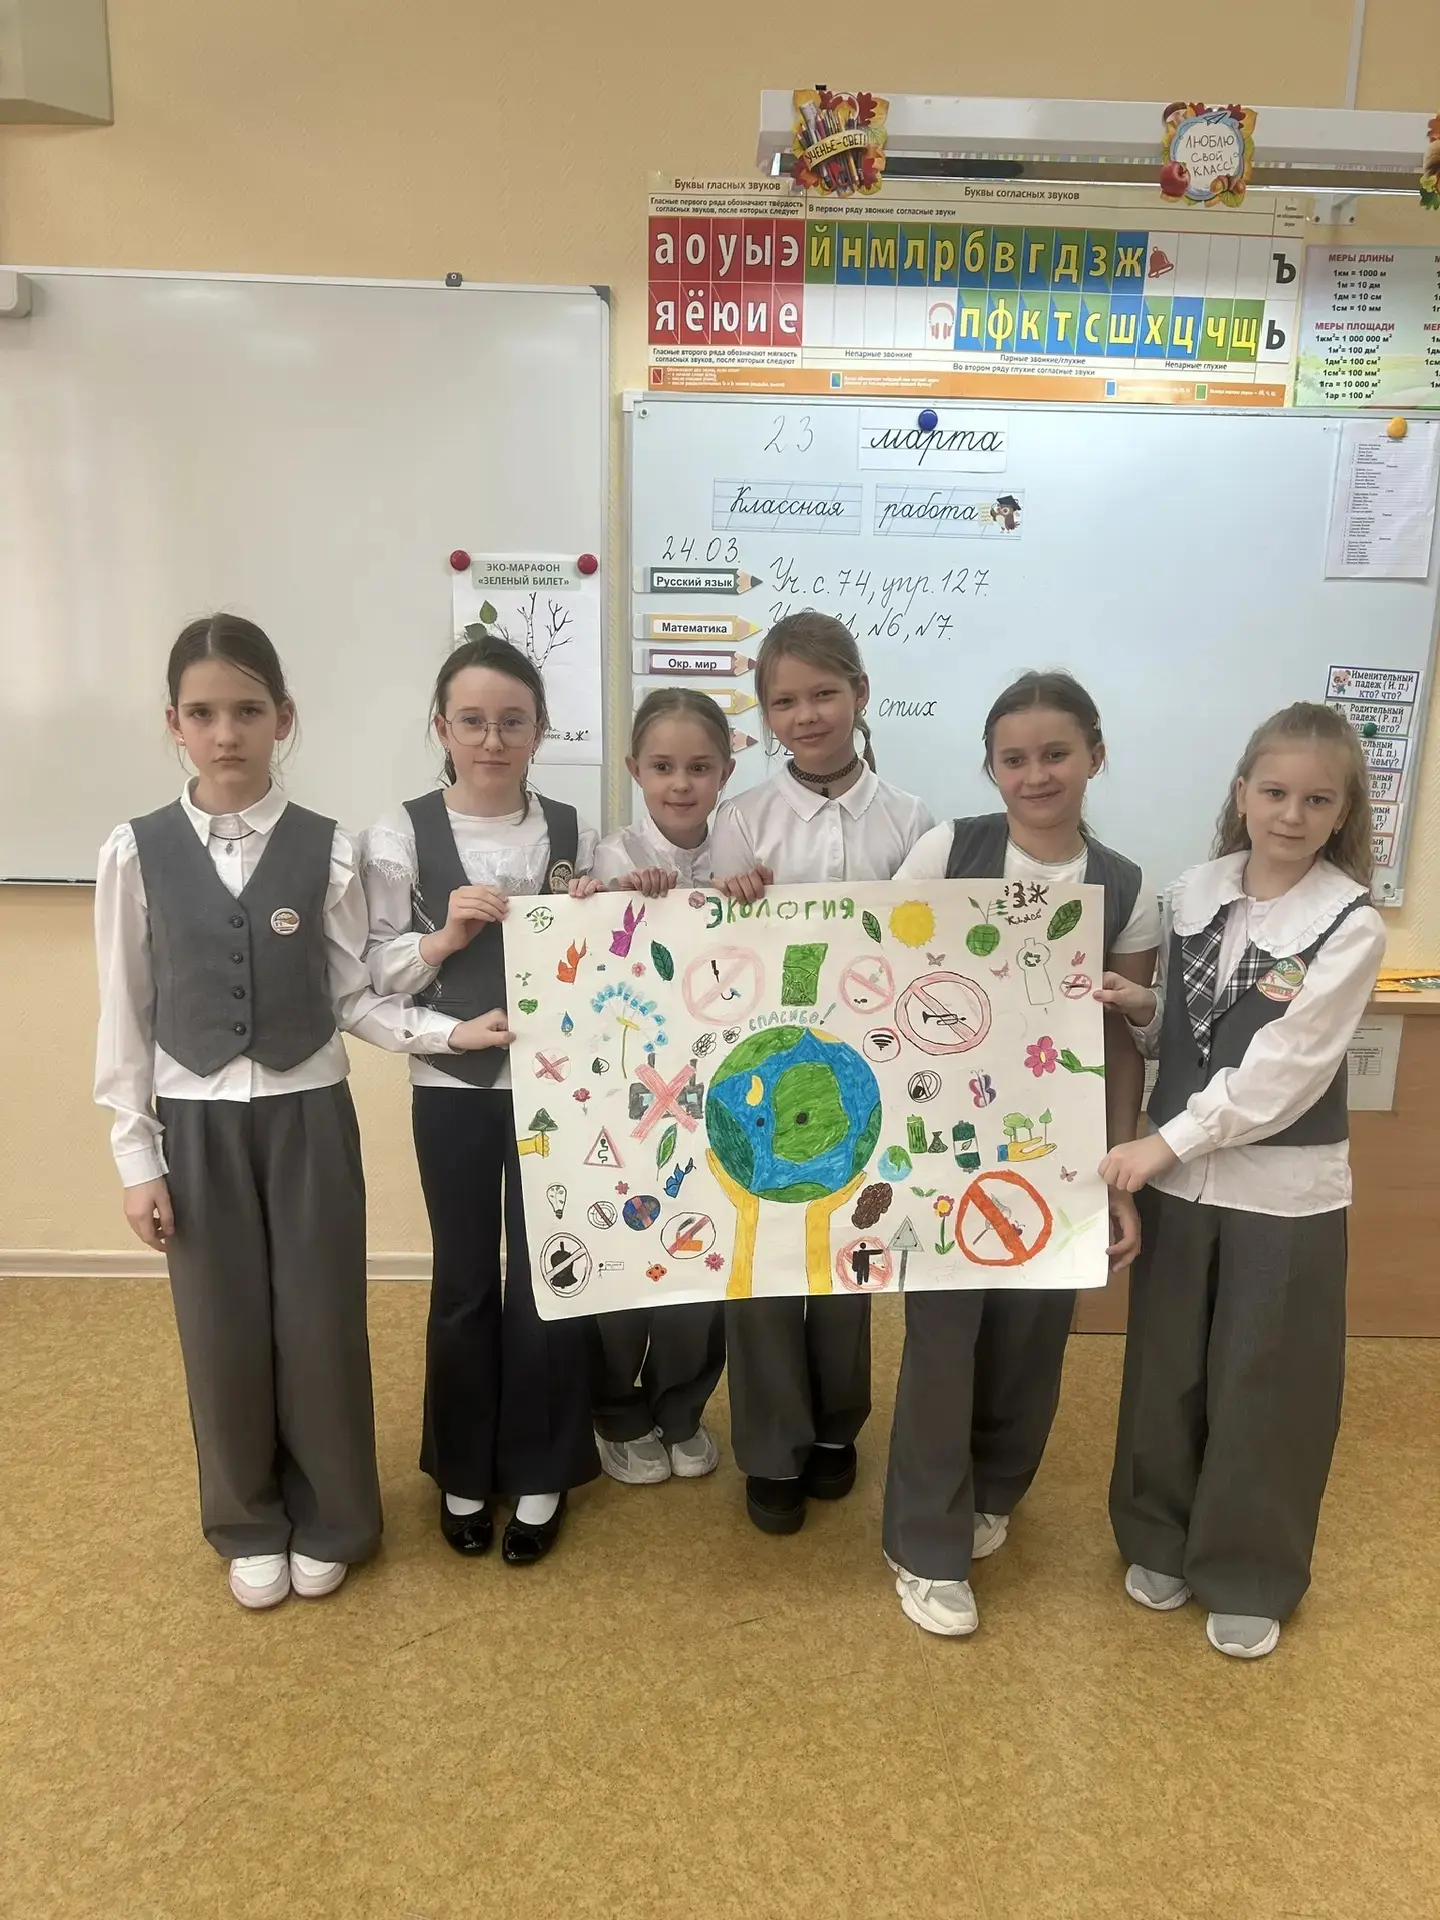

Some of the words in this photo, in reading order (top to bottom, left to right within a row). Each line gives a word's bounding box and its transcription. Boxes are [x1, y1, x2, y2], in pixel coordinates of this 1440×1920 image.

[1186, 134, 1234, 148] ЛЮБЛЮ
[1193, 156, 1234, 177] КЛАСС!
[675, 178, 704, 191] Буквы
[707, 181, 745, 190] гласных
[748, 182, 780, 191] звуков
[964, 186, 994, 199] Буквы
[996, 189, 1045, 200] согласных
[1048, 190, 1080, 201] звуков
[650, 197, 679, 205] Гласные
[769, 208, 799, 216] следуют
[896, 208, 934, 216] согласные
[1328, 254, 1356, 262] МЕРЫ
[1358, 254, 1394, 263] ДЛИНЫ
[1315, 322, 1344, 330] МЕРЫ
[1346, 322, 1395, 332] ПЛОЩАДИ
[652, 348, 680, 356] Гласные
[727, 349, 766, 357] обозначают
[767, 350, 798, 358] мягкость
[845, 350, 881, 358] Непарные
[766, 358, 796, 366] следуют
[1000, 354, 1028, 363] Парные
[1030, 356, 1086, 365] звонкие/глухие
[964, 364, 990, 372] втором
[992, 365, 1009, 373] ряду
[1011, 366, 1035, 374] глухие
[1037, 367, 1073, 375] согласные
[1074, 368, 1096, 376] звуки
[1165, 361, 1202, 370] Непарные
[1203, 363, 1227, 371] глухие
[1325, 392, 1339, 400] 1ар
[764, 414, 814, 453] 23
[870, 427, 1004, 466] марта
[730, 486, 844, 516] Классная
[878, 492, 978, 529] работа
[662, 535, 741, 564] 24.03.
[486, 563, 560, 572] ЭКО-МАРАФОН
[478, 575, 530, 586] «ЗЕЛЕНЫЙ
[533, 577, 570, 586] БИЛЕТ»
[656, 576, 701, 588] Русский
[704, 578, 732, 589] язык
[662, 622, 728, 634] Математика
[668, 658, 692, 670] Окр.
[695, 660, 717, 672] мир
[1352, 670, 1414, 682] Именительный
[1355, 680, 1382, 689] падеж
[1359, 690, 1379, 698] кто?
[1382, 691, 1401, 700] что?
[878, 697, 937, 717] стих
[1350, 704, 1404, 715] Родительный
[1350, 714, 1376, 722] падеж
[1371, 758, 1399, 768] чему?
[750, 1002, 836, 1031] СПАСИБО!
